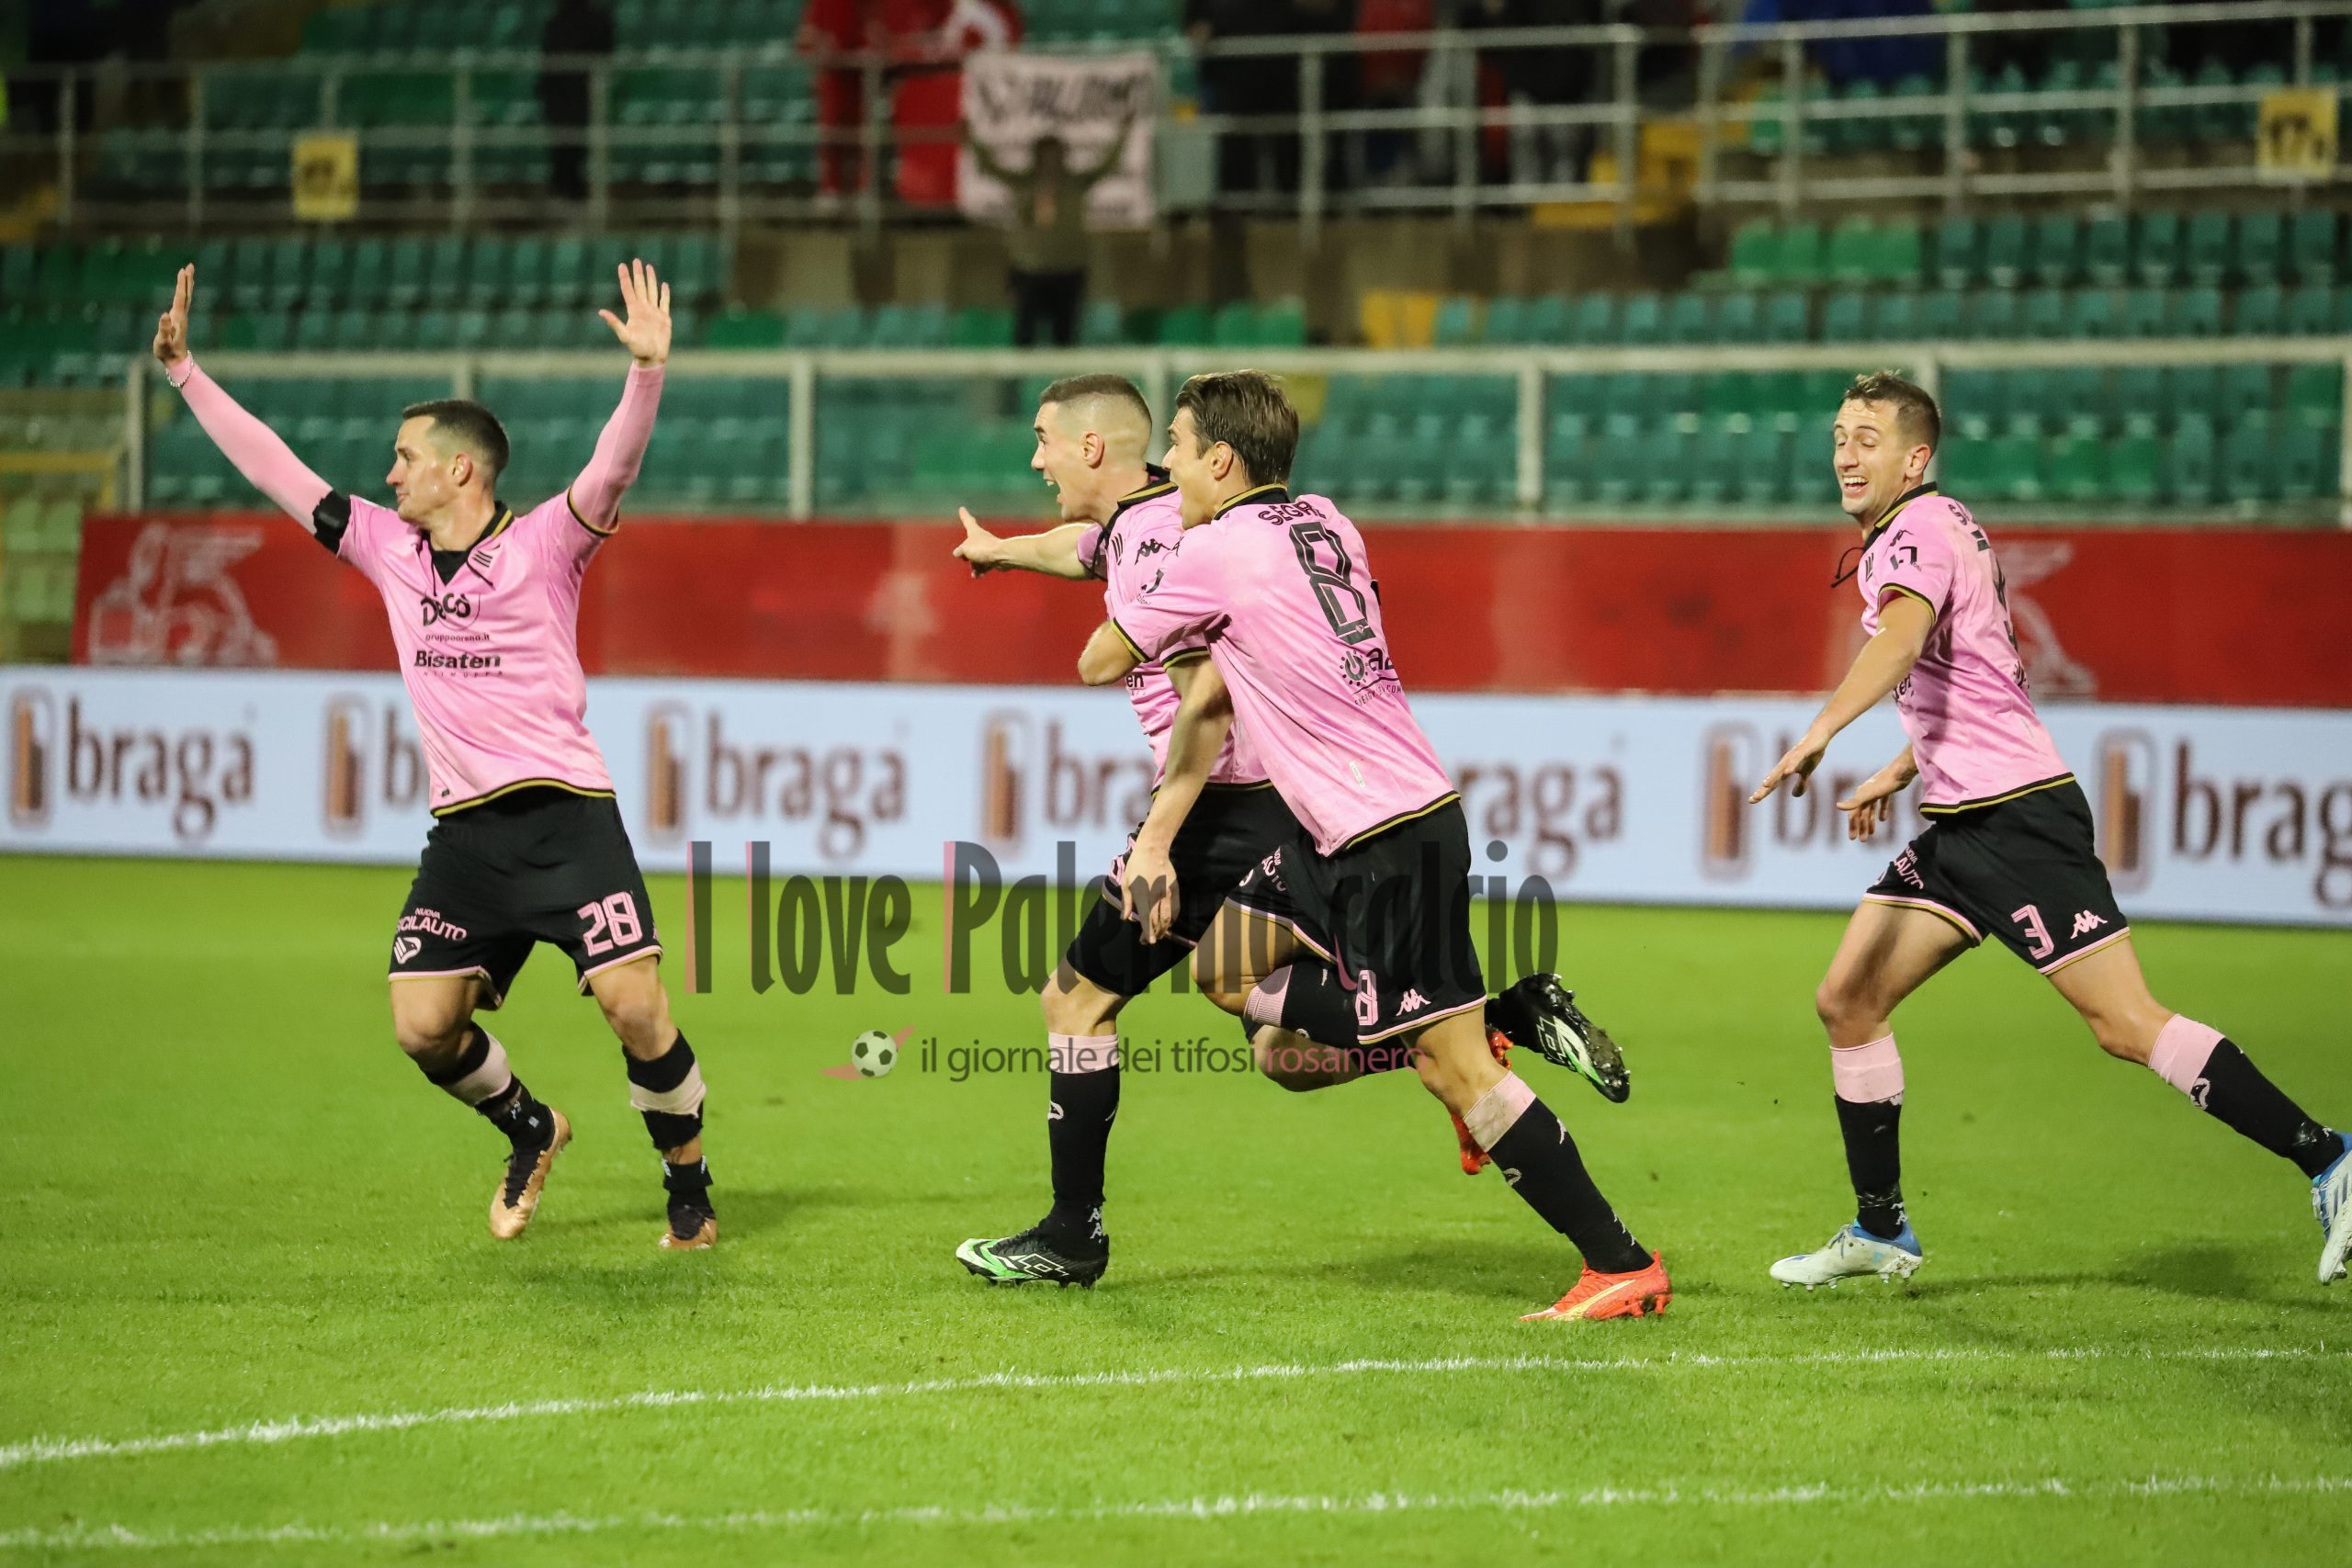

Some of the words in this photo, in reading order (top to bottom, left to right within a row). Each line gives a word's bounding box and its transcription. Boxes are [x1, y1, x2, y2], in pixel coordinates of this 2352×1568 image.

[1289, 522, 1376, 645] 8
[414, 649, 501, 669] Bisaten
[66, 695, 255, 841] braga
[706, 711, 906, 860] braga
[1046, 721, 1154, 826] bra
[1455, 761, 1623, 881] raga
[2172, 738, 2352, 908] brag
[576, 890, 643, 957] 28
[2011, 904, 2054, 960] 3
